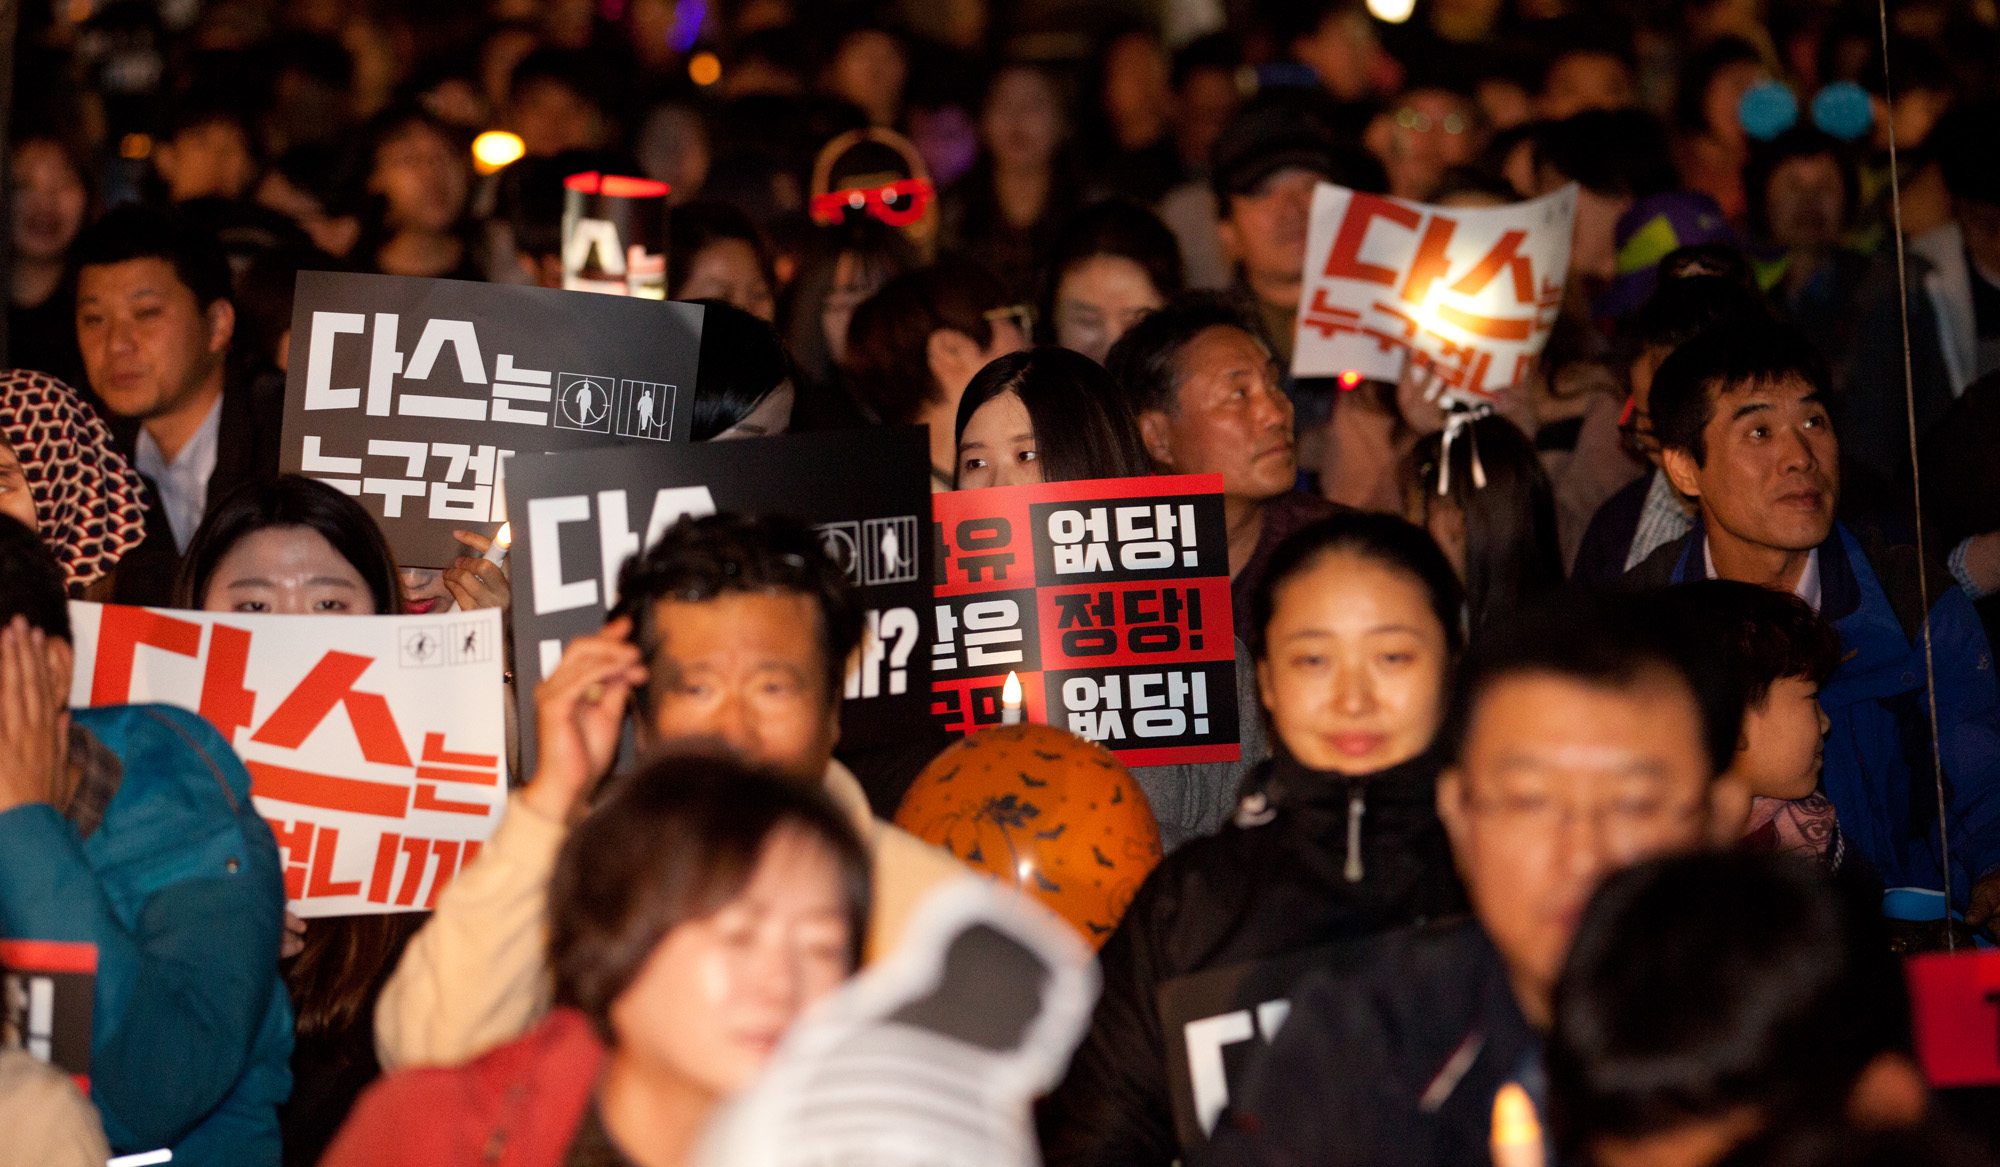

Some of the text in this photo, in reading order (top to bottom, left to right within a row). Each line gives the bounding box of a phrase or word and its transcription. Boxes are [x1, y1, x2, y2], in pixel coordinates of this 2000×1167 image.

[304, 311, 552, 426] 다스는
[1048, 504, 1198, 575] 없당!
[1055, 587, 1204, 657] 정당!
[1062, 671, 1209, 740] 없당!
